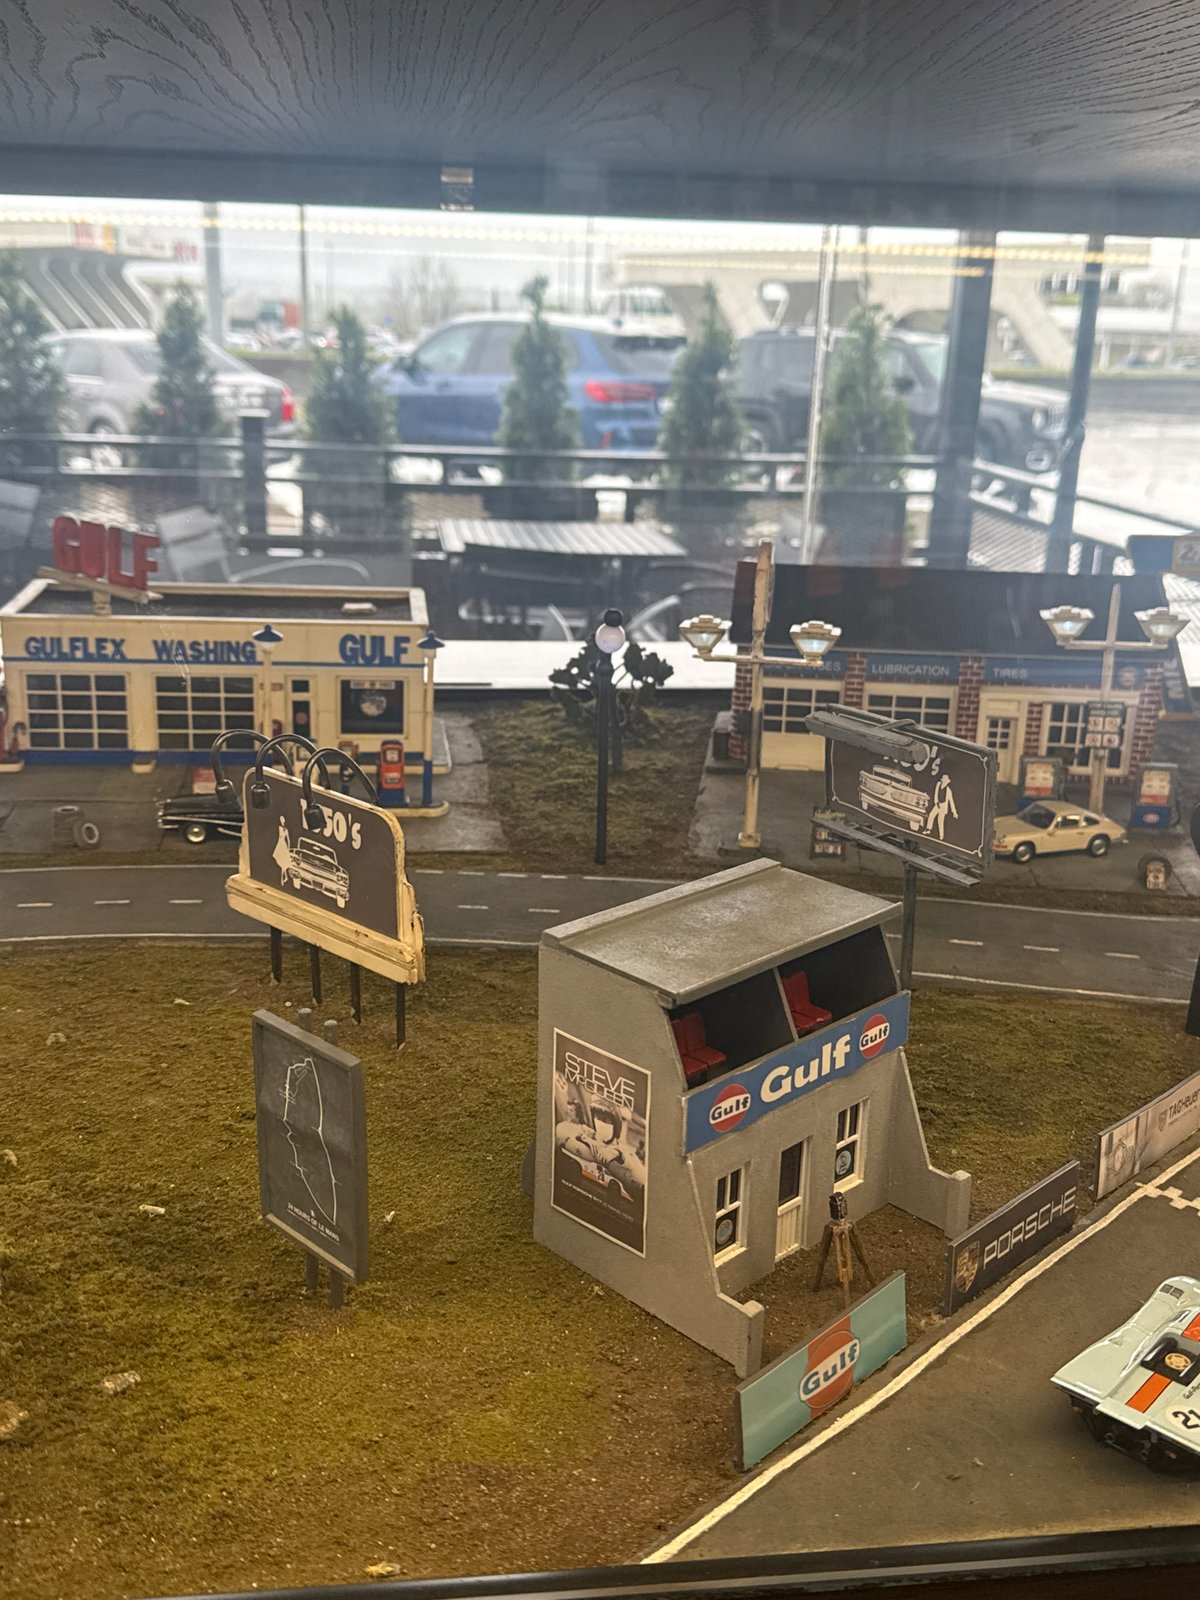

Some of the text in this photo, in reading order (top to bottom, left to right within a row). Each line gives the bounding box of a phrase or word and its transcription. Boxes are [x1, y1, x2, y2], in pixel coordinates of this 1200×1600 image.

[53, 516, 161, 591] GULF
[24, 636, 257, 664] GULFLEX WASHING
[338, 633, 411, 667] GULF
[871, 663, 950, 676] LUBRICATION
[993, 667, 1029, 679] TIRES
[565, 1052, 636, 1095] STEVE
[710, 1025, 889, 1121] Gulf Gulf Gulf
[983, 1185, 1077, 1270] PORSCHE
[802, 1342, 857, 1396] Gulf
